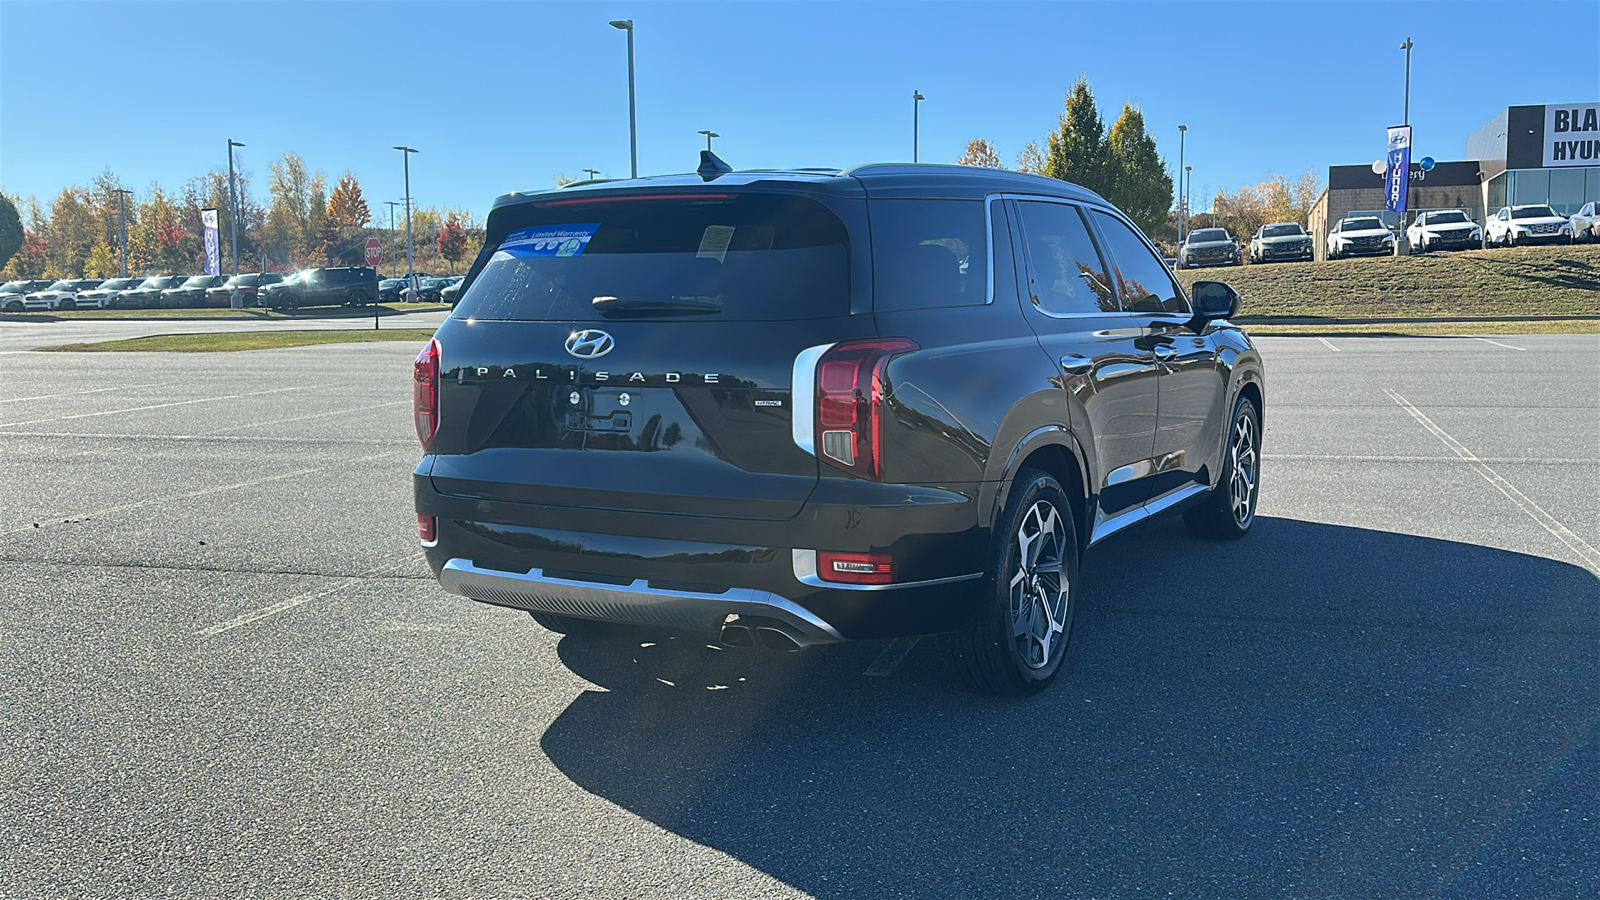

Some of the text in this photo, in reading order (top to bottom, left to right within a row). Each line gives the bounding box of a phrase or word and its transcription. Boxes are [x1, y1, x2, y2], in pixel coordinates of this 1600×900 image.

[1554, 109, 1600, 132] BLA
[1391, 152, 1402, 209] HYUNDAI
[531, 231, 556, 239] Limited
[557, 230, 591, 238] Warranty
[207, 229, 215, 274] HYUNDAI
[366, 246, 381, 258] STOP
[477, 367, 719, 384] PALISADE
